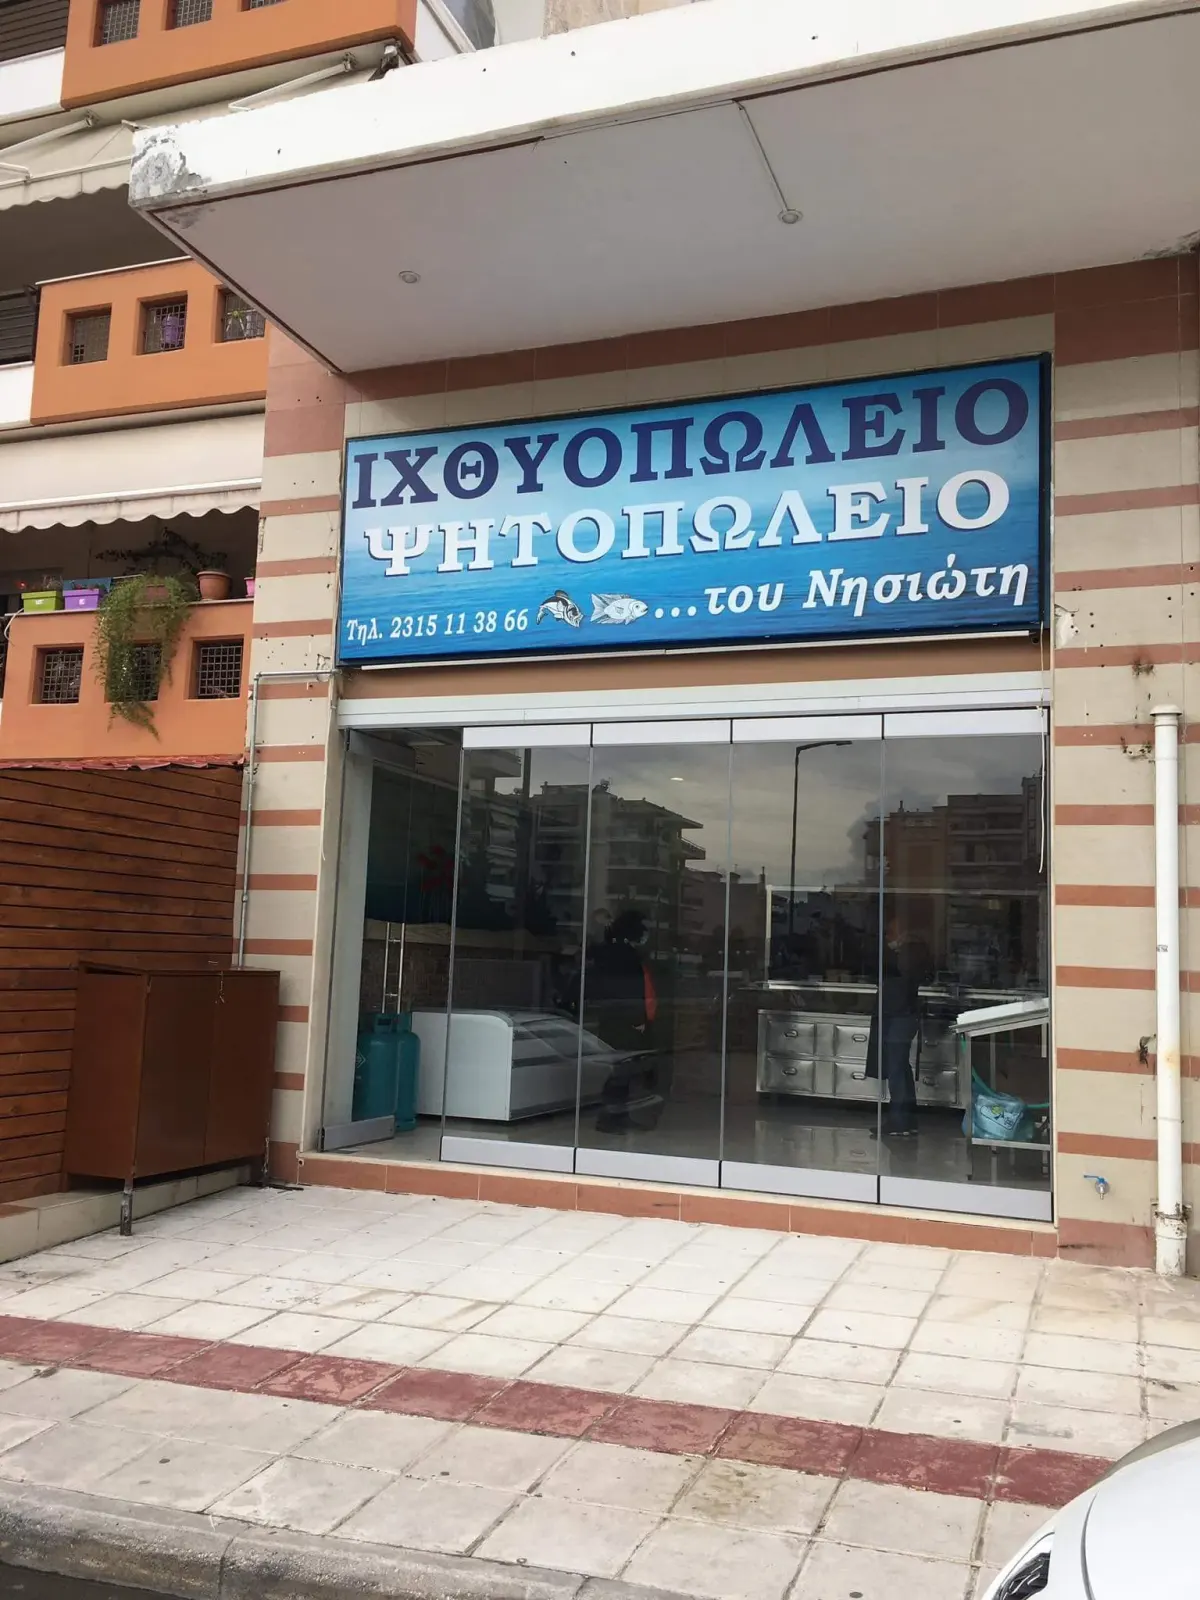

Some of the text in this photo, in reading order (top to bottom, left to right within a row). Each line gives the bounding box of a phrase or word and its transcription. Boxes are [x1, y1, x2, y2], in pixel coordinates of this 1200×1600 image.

[352, 378, 1029, 510] ΙΧΘΥΟΠΩΛΕΙΟ
[363, 470, 1010, 577] ΨΗΤΟΠΩΛΕΙΟ
[346, 608, 529, 646] Τηλ. 2315 11 38 66
[802, 553, 1029, 617] Νησιώτη
